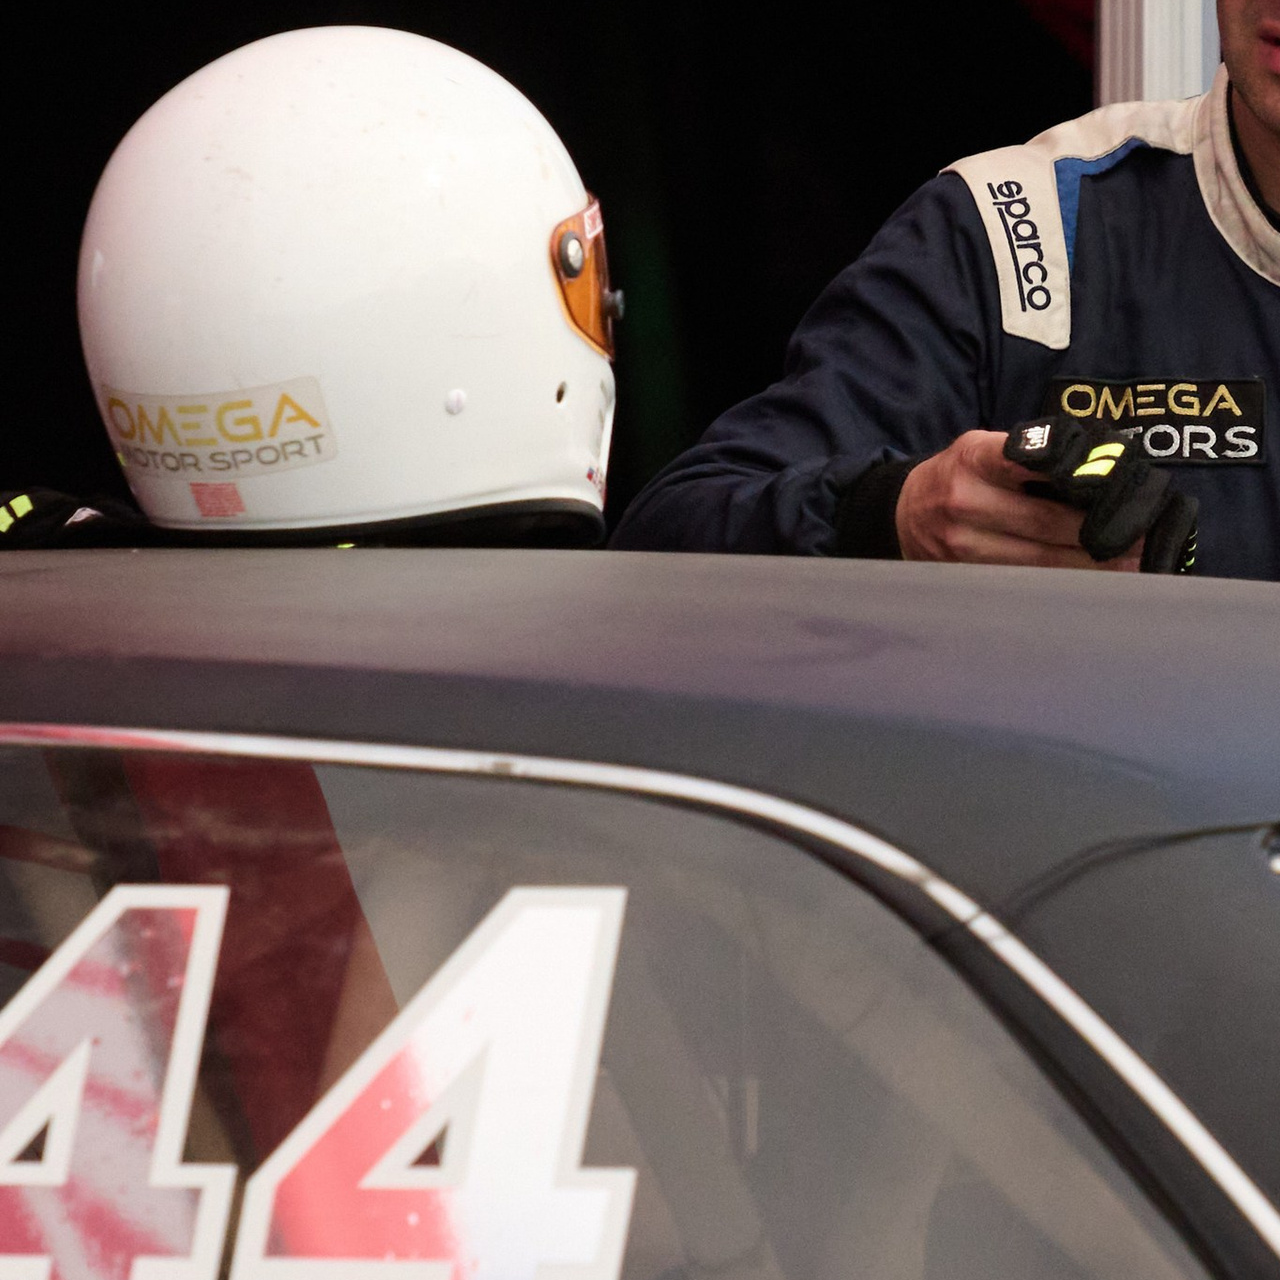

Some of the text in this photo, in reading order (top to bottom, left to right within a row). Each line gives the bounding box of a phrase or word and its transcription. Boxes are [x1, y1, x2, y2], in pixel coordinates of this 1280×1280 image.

[988, 180, 1052, 312] sparco
[107, 392, 322, 447] OMEGA
[1060, 383, 1243, 421] OMEGA
[209, 432, 326, 472] SPORT
